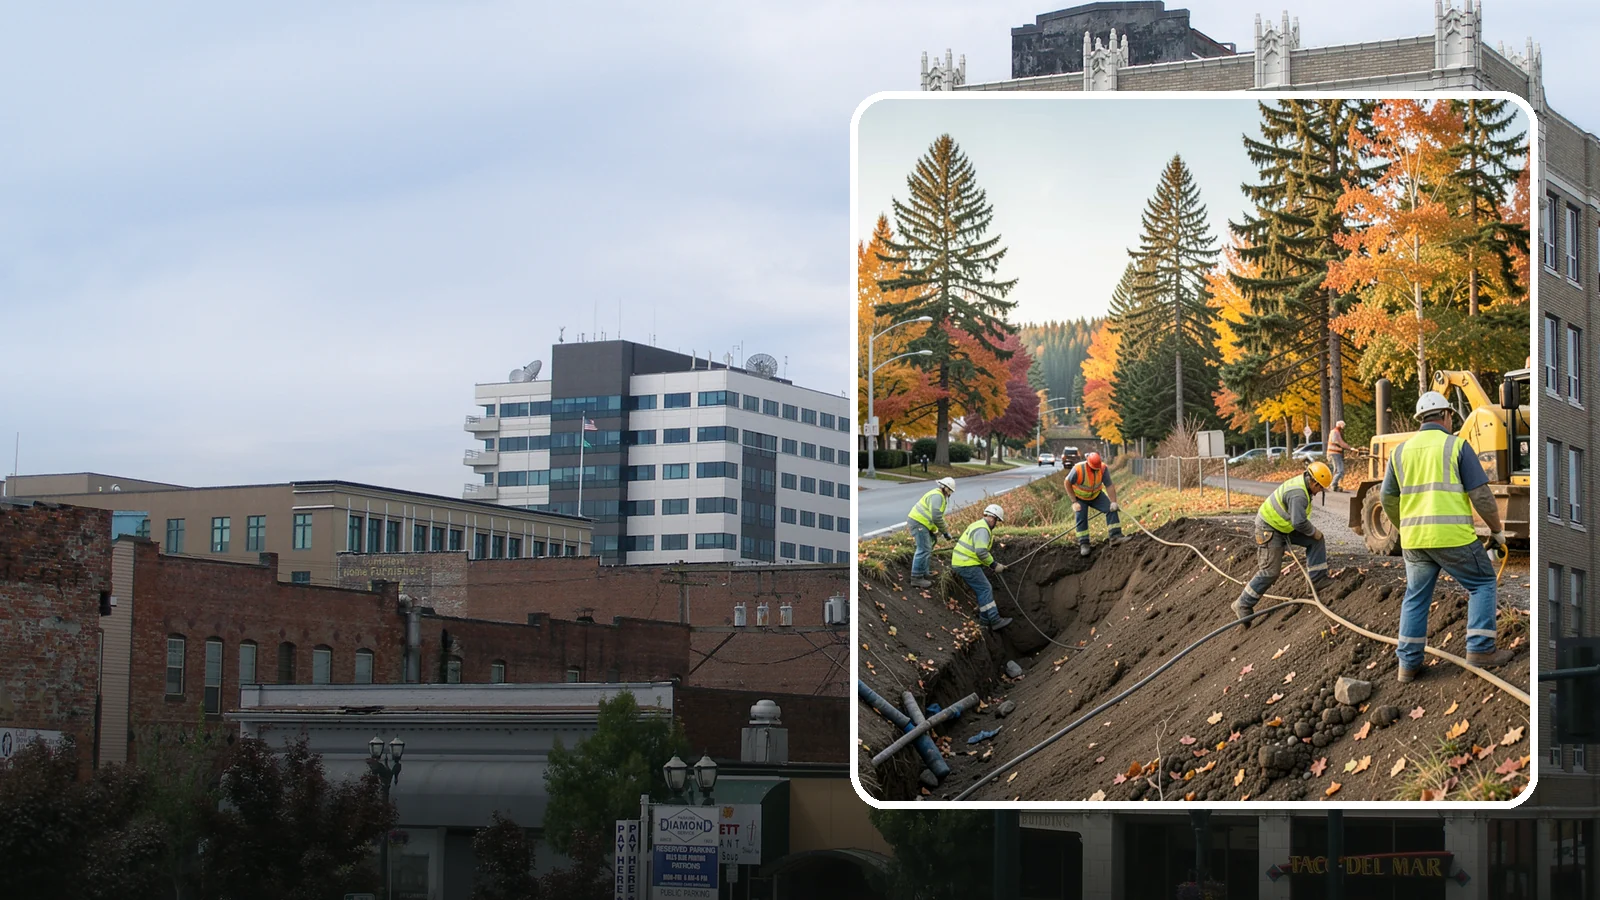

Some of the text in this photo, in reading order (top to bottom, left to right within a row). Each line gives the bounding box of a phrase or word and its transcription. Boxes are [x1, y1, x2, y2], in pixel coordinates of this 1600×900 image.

[370, 566, 427, 577] Furnishers
[660, 818, 713, 833] DIAMOND
[1022, 815, 1069, 828] BUILDING
[656, 845, 716, 854] RESERVED PARKING
[616, 825, 625, 894] PAY HERE
[627, 824, 637, 894] PAY HERE
[721, 851, 739, 862] Soup
[671, 862, 701, 870] PATRONS
[1346, 857, 1385, 876] DEL
[1392, 857, 1442, 877] MAR
[660, 888, 710, 898] PUBLIC PARKING
